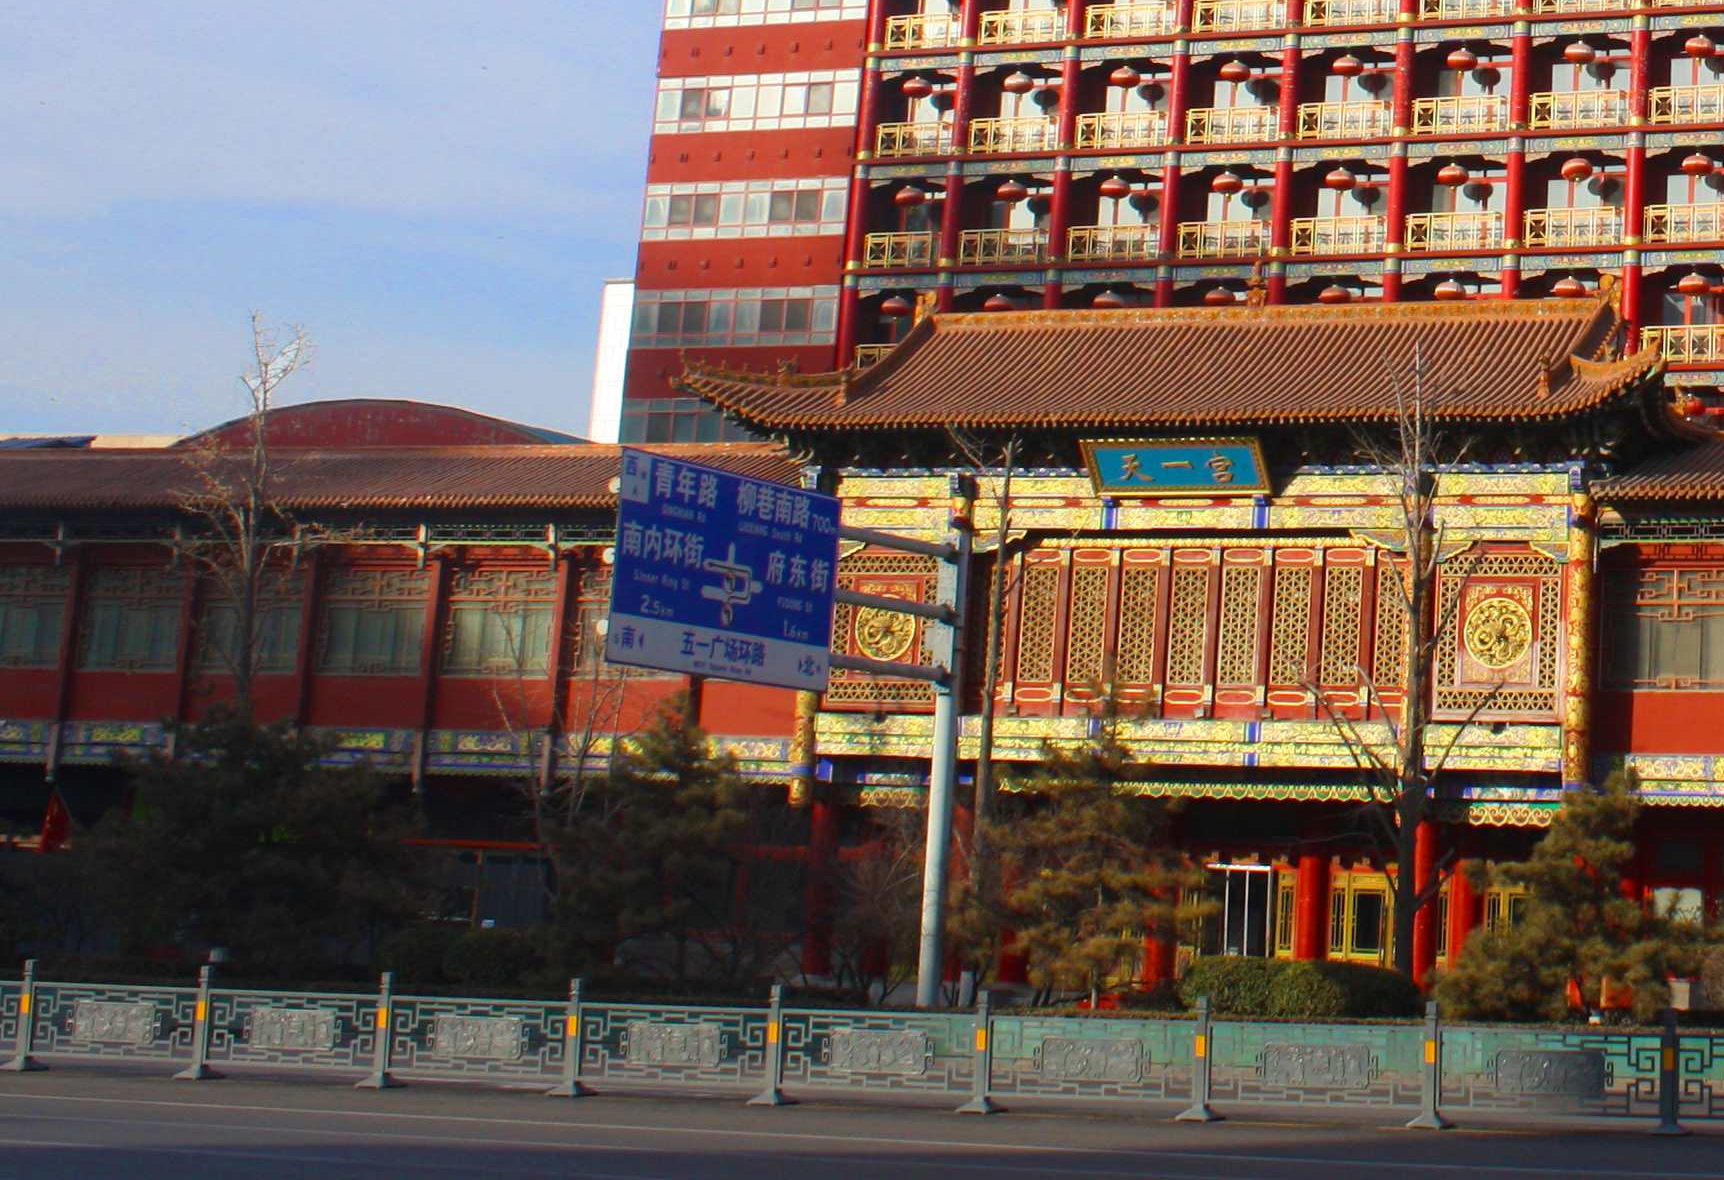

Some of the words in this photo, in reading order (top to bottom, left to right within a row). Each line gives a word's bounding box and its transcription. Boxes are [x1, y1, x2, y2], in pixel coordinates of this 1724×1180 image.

[655, 461, 718, 508] 青年路
[1119, 451, 1235, 483] 天一宫
[737, 480, 810, 529] 柳巷南路
[621, 520, 704, 570] 南内环街
[766, 550, 829, 593] 府东街
[621, 626, 635, 649] 南
[681, 631, 766, 668] 五一广场环路
[803, 655, 815, 676] 北
